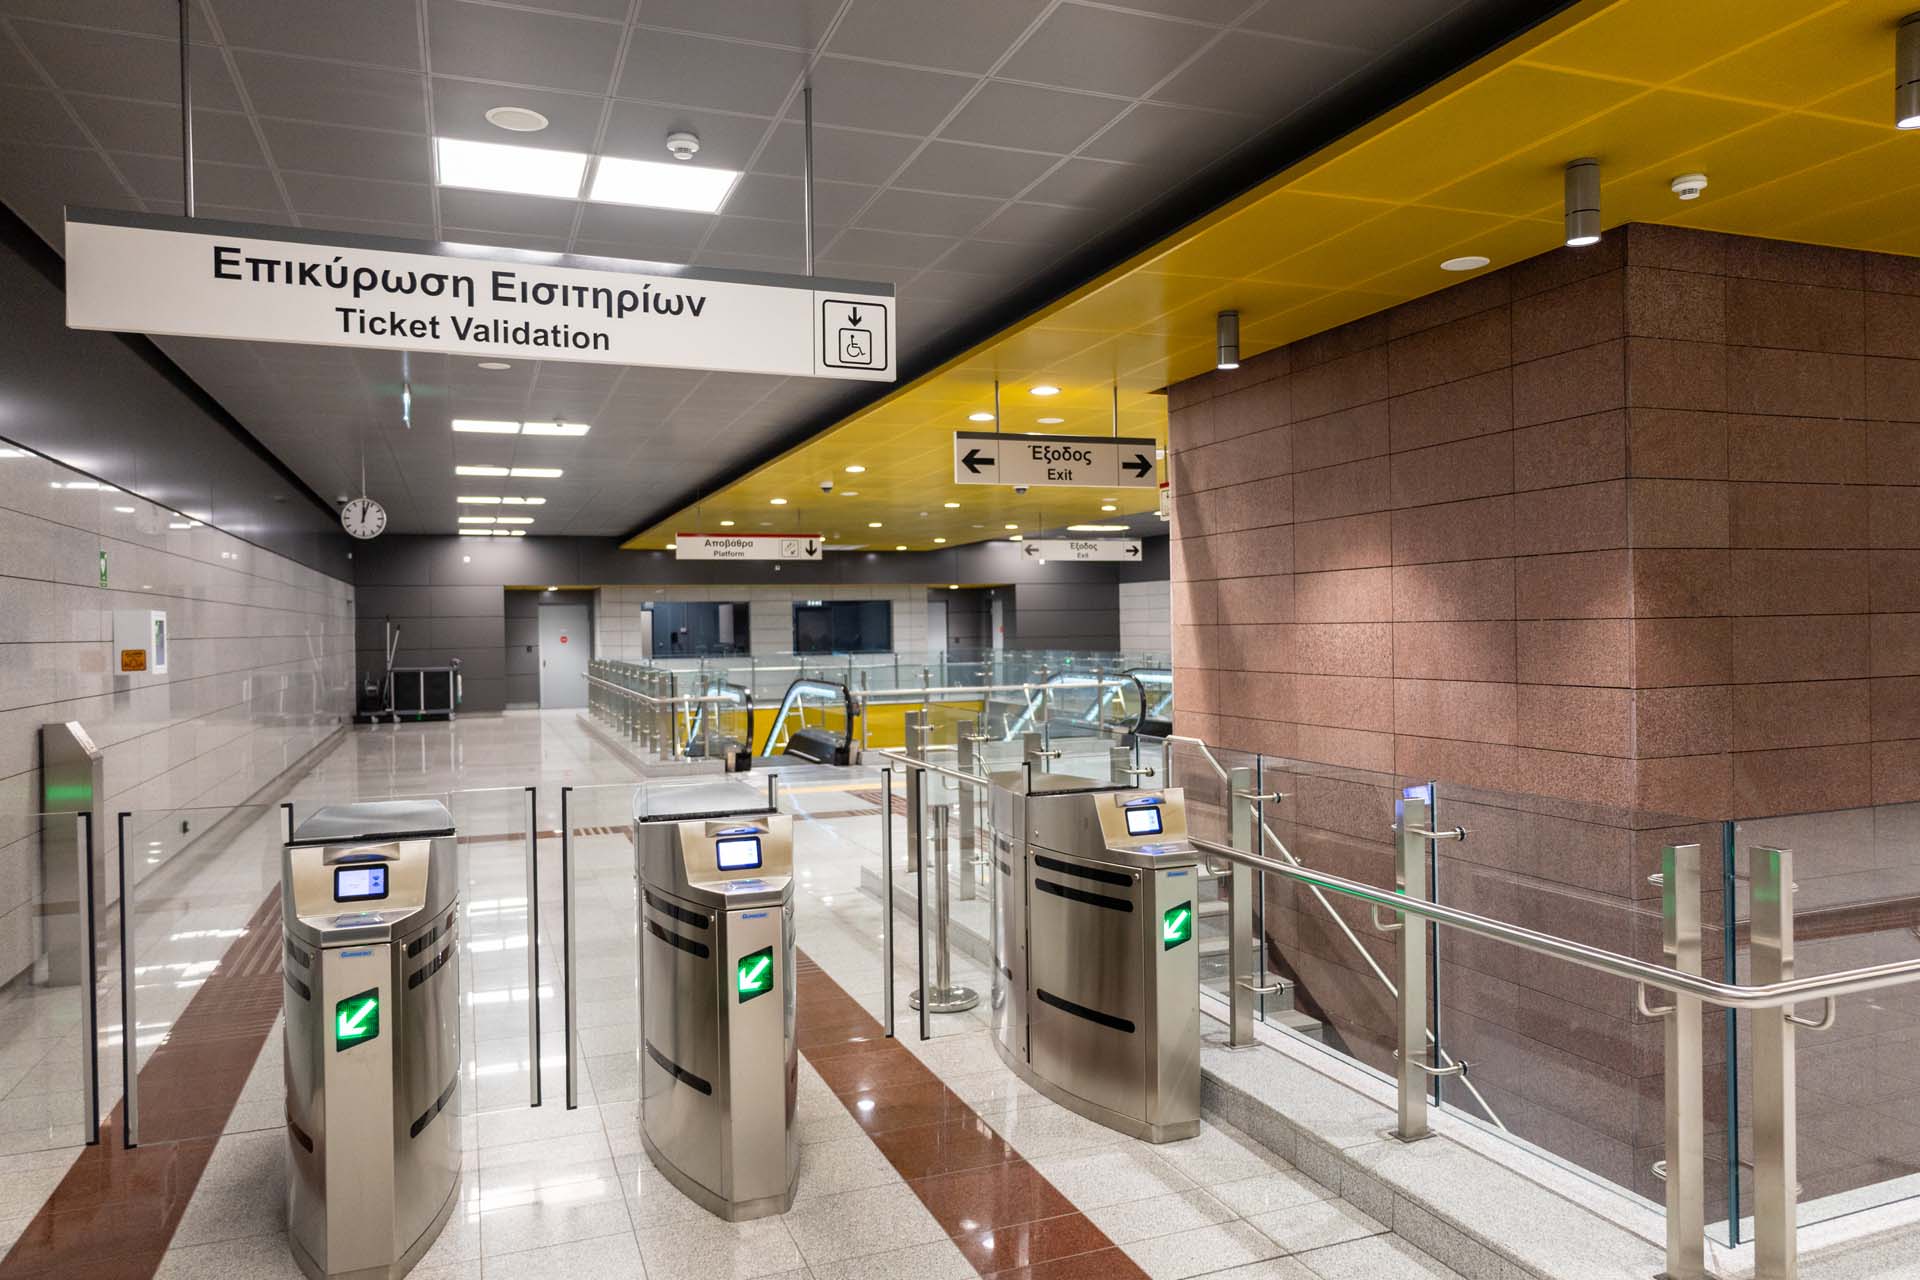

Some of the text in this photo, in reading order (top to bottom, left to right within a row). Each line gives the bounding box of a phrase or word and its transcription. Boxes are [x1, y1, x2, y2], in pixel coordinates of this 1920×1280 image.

[214, 246, 706, 318] Επικύρωση Εισιτηρίων
[336, 307, 609, 351] Ticket Validation
[1028, 445, 1092, 465] Έξοδος
[1047, 469, 1073, 481] Exit
